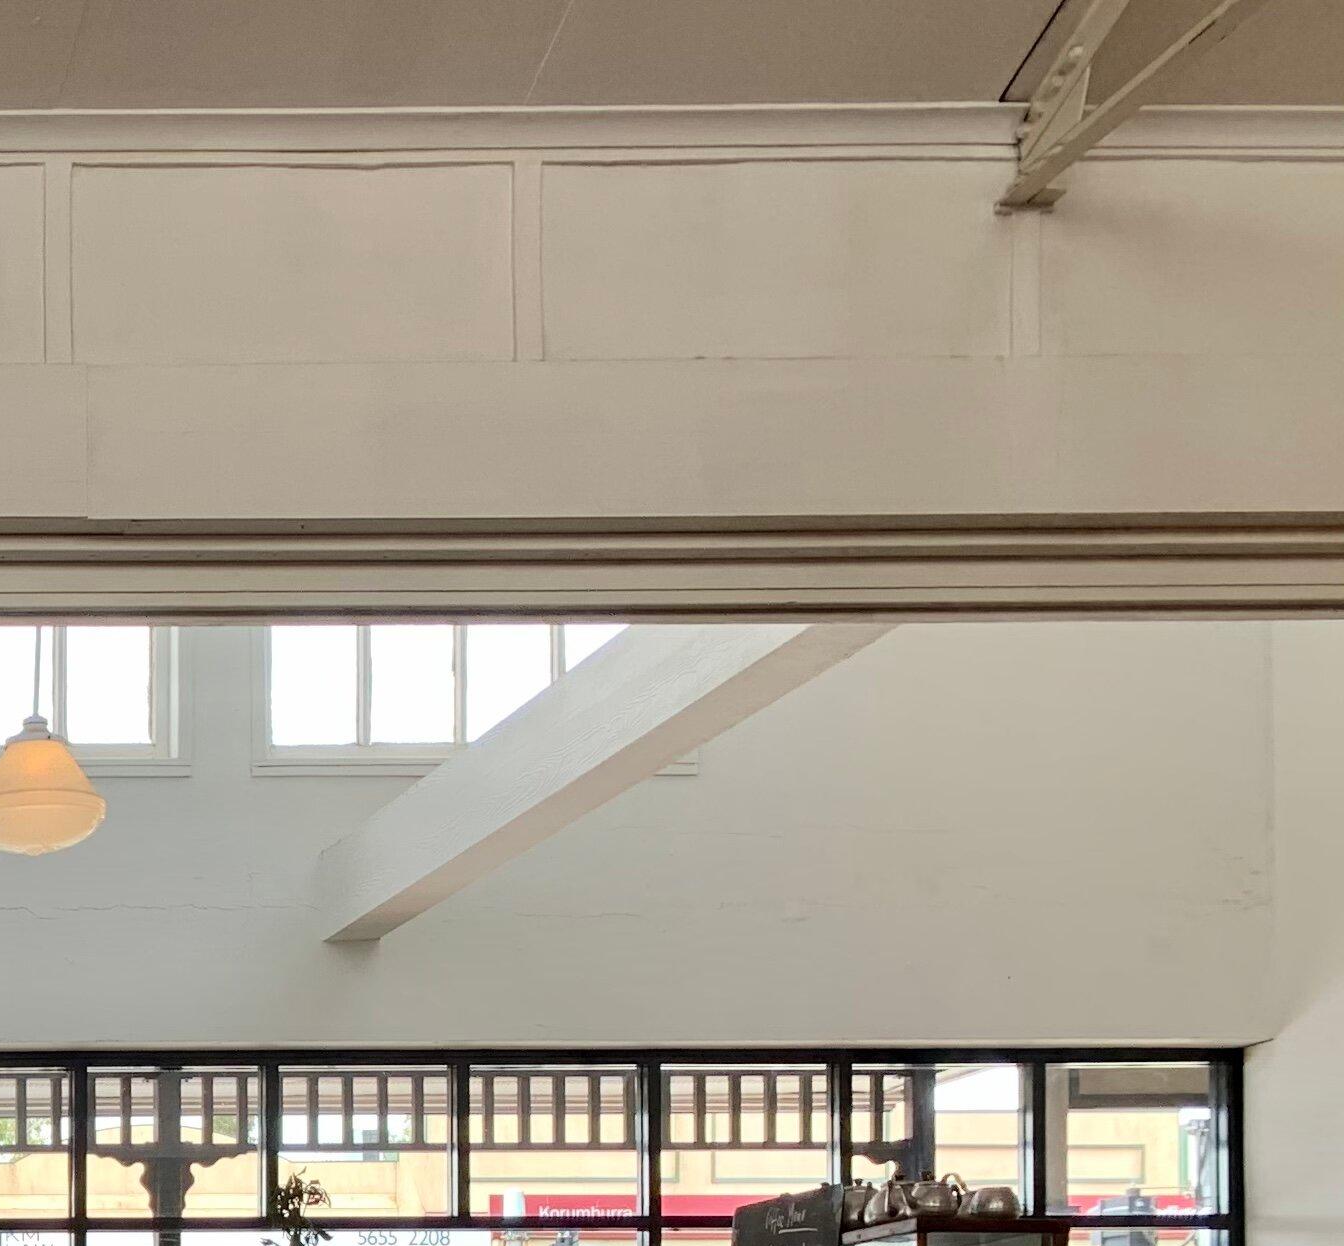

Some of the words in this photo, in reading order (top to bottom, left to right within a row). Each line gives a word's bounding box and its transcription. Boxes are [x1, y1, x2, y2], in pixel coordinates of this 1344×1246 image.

[538, 1205, 633, 1218] Korumburra
[5, 1232, 40, 1242] KM
[357, 1230, 398, 1246] 5655
[408, 1230, 451, 1246] 2208
